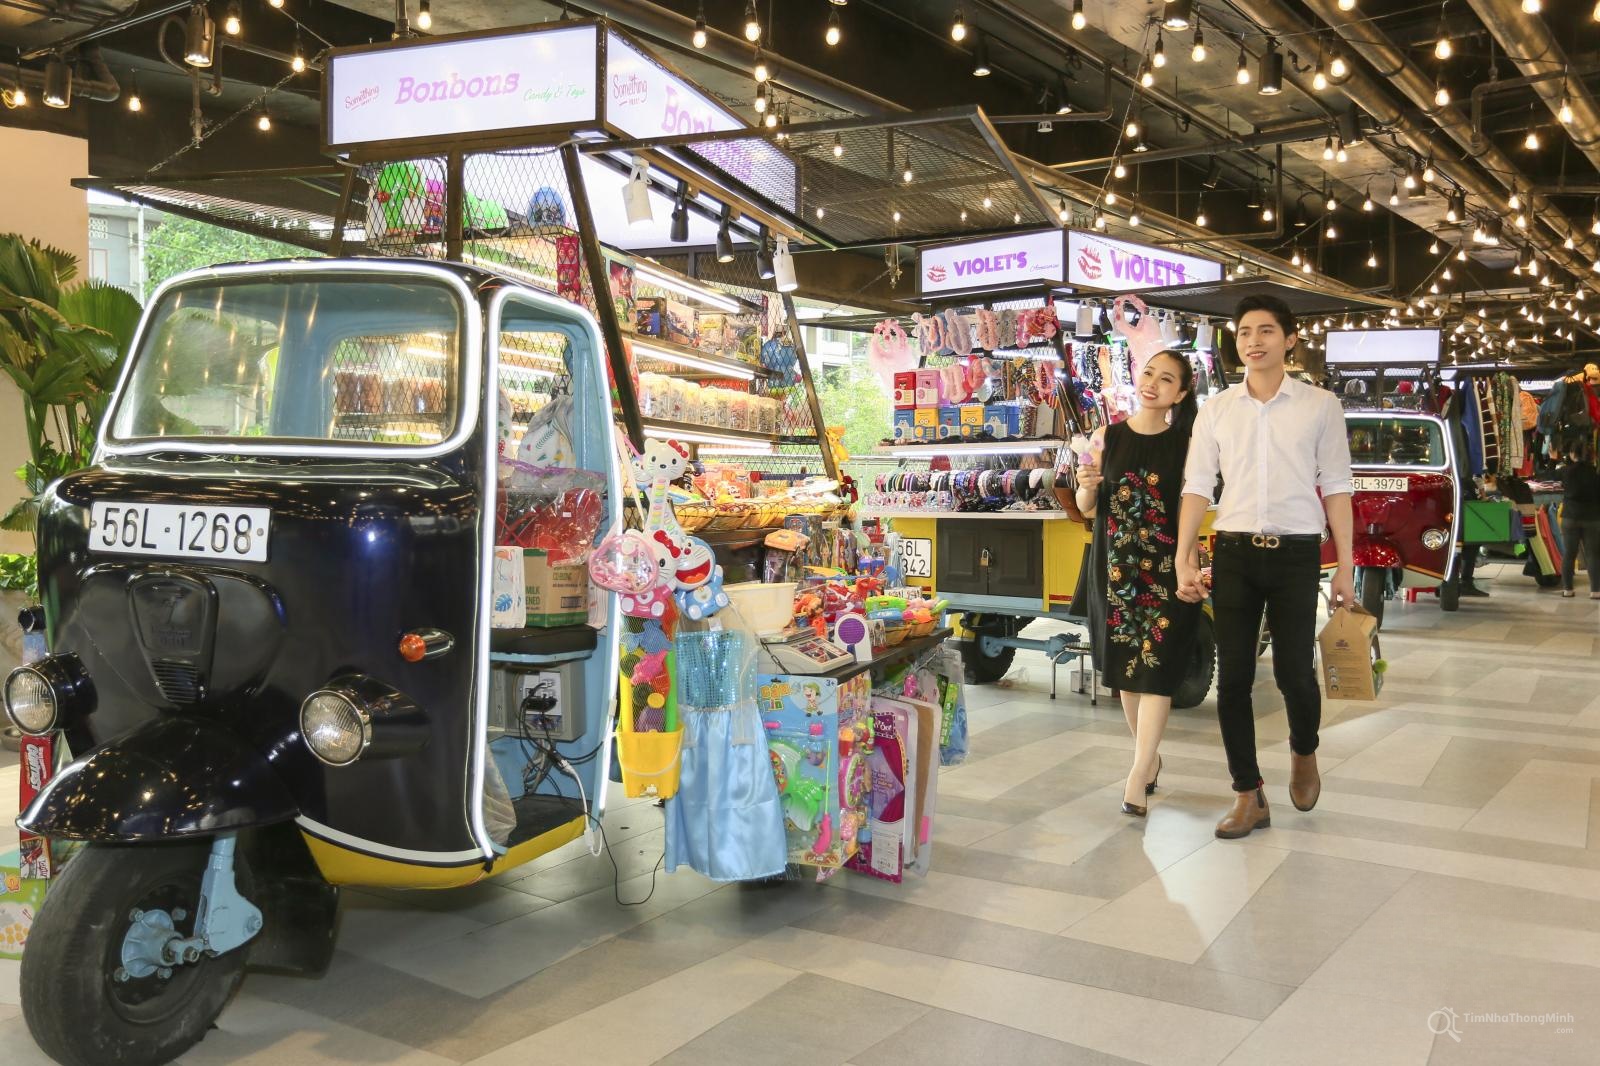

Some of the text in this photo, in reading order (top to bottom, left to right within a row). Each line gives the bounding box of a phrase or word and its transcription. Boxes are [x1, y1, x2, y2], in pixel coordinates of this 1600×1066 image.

[395, 73, 520, 104] Bonbons
[953, 251, 1028, 277] VIOLET'S
[1110, 249, 1186, 285] VIOLET'S
[898, 540, 921, 556] 56L
